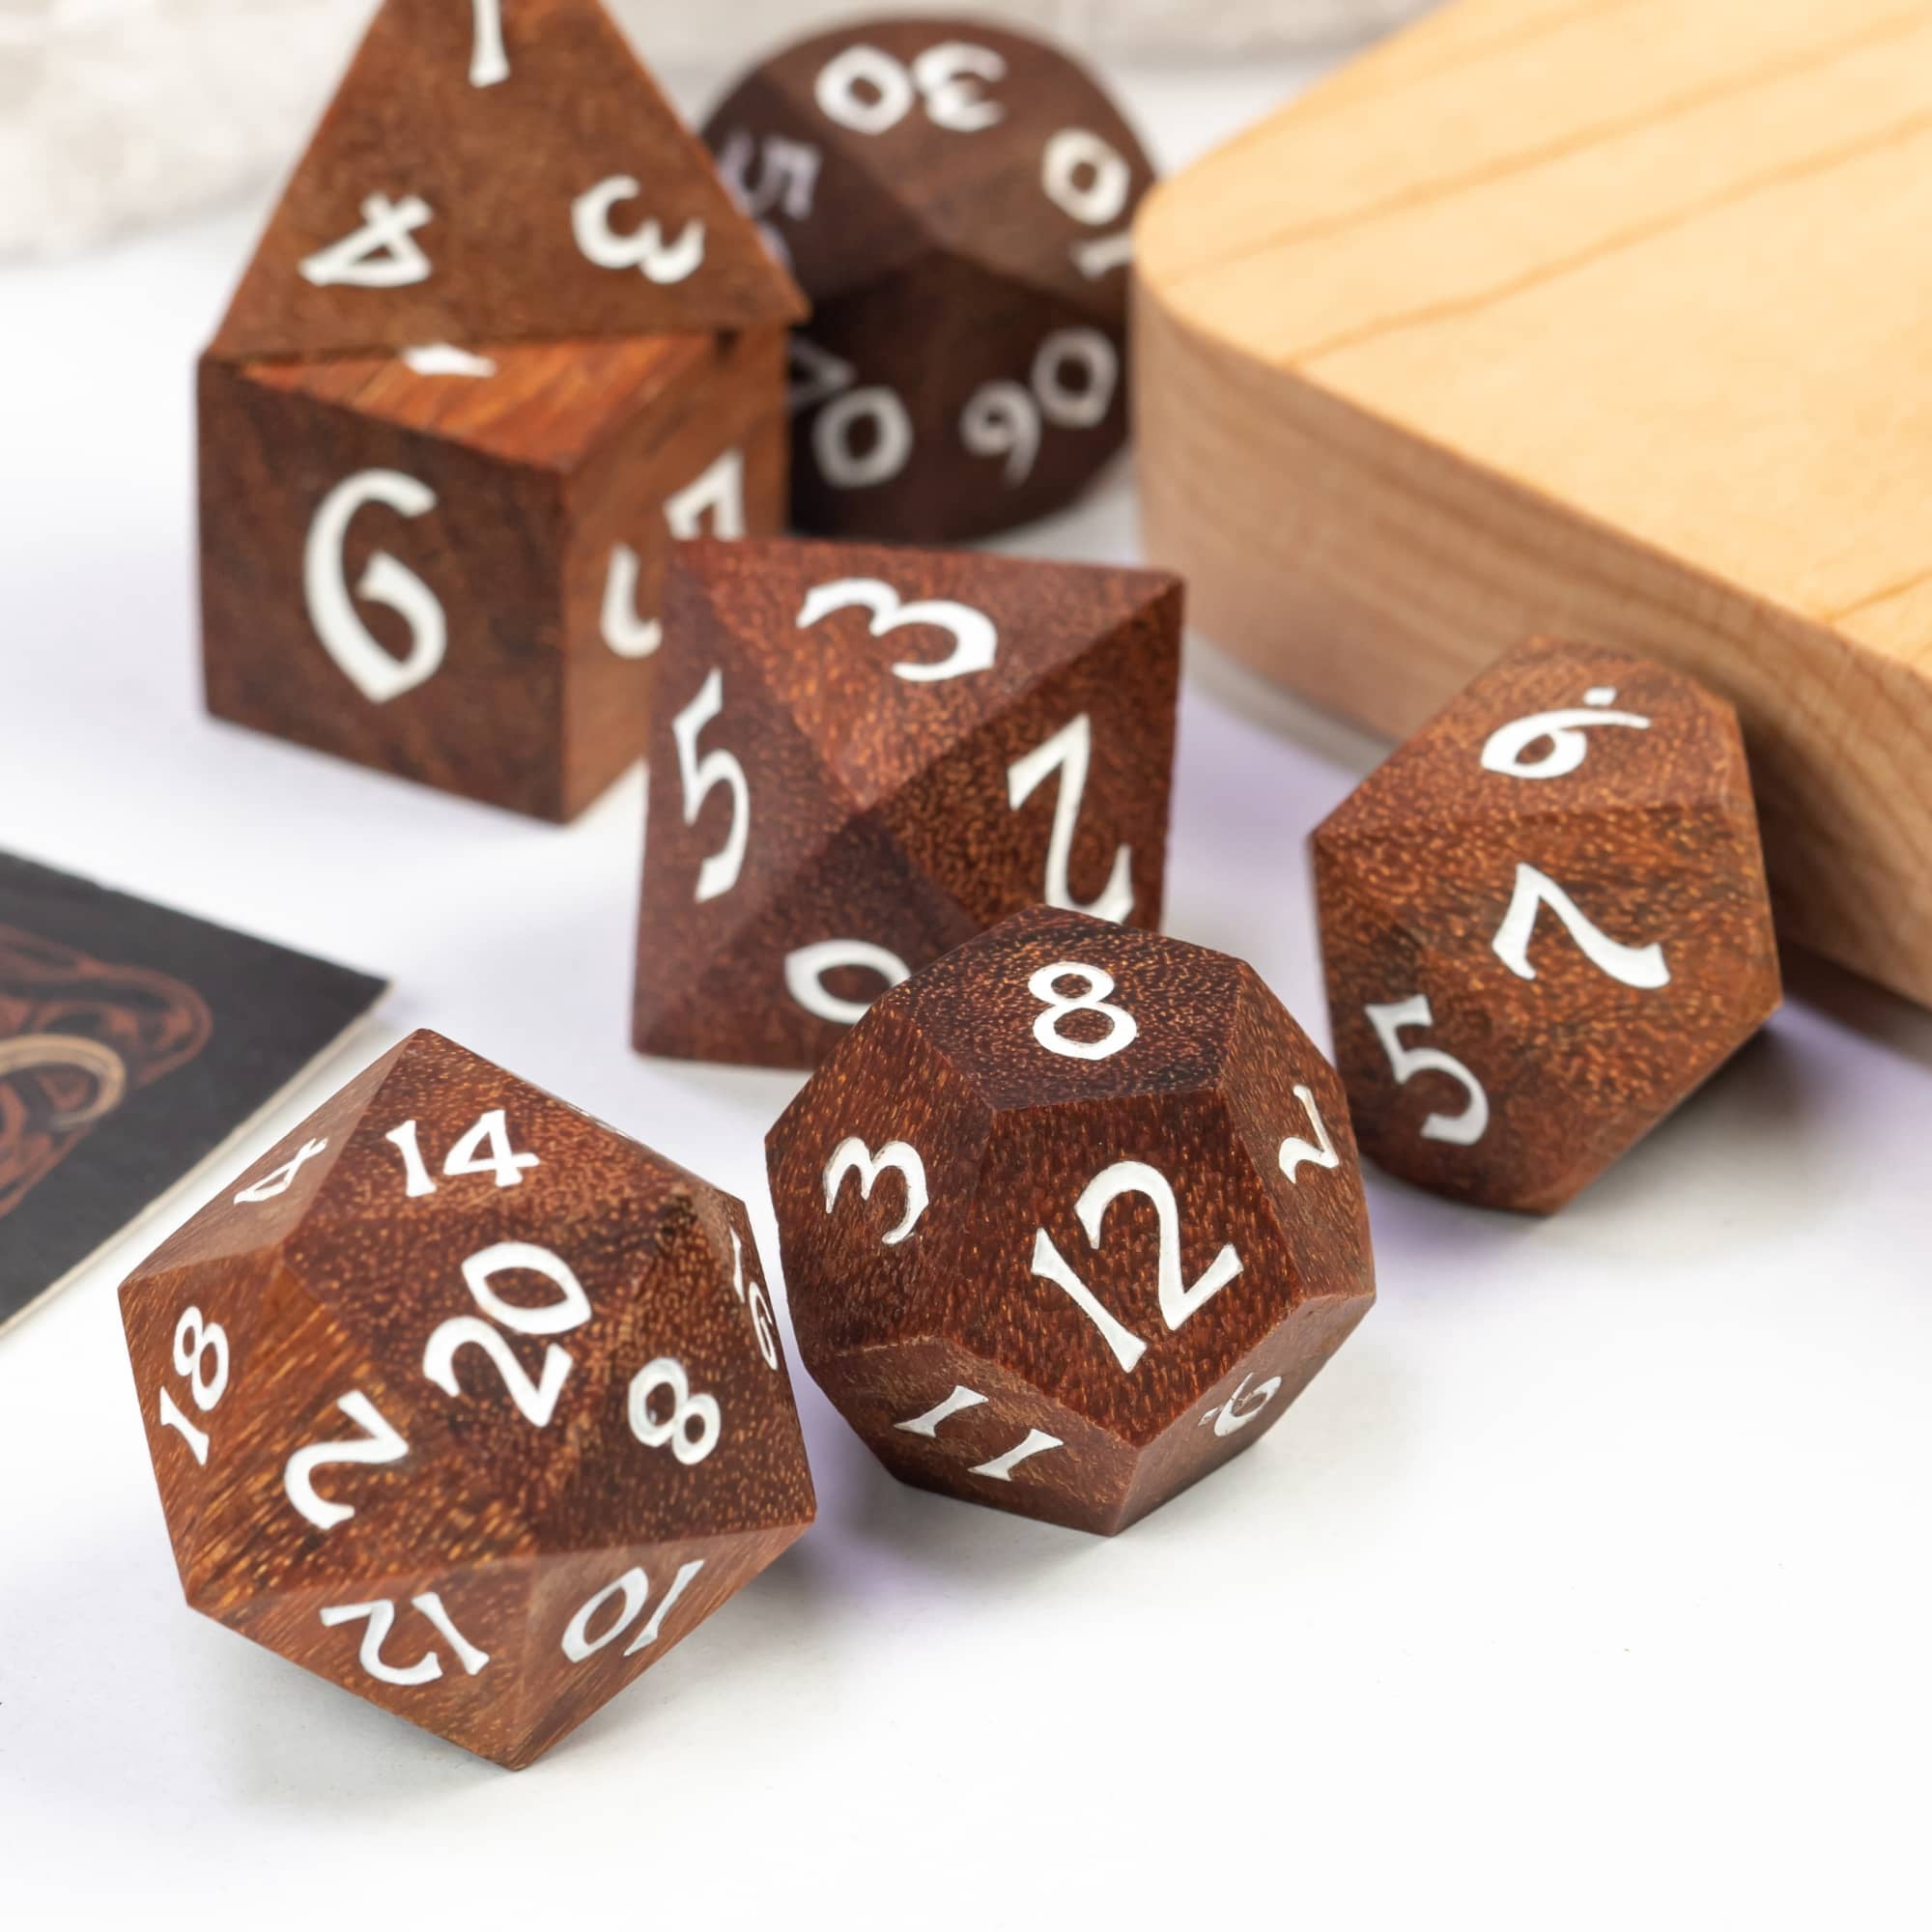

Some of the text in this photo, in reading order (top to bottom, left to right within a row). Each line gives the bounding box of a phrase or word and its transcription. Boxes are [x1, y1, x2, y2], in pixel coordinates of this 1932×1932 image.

[301, 195, 431, 287] 4
[572, 176, 704, 284] 3
[304, 469, 447, 704] 6
[796, 578, 999, 682] 3
[670, 668, 752, 903] 5
[1027, 960, 1141, 1062] 8
[1364, 994, 1490, 1144] 5
[231, 1135, 329, 1206] 4
[384, 1108, 542, 1199] 14
[822, 1136, 930, 1246] 3
[1030, 1160, 1245, 1374] 12
[158, 1305, 231, 1467] 18
[421, 1240, 594, 1429] 20
[283, 1389, 411, 1532] 2
[626, 1356, 723, 1466] 8
[894, 1384, 1065, 1483] 11
[319, 1590, 492, 1687] 12
[559, 1558, 706, 1664] 10
